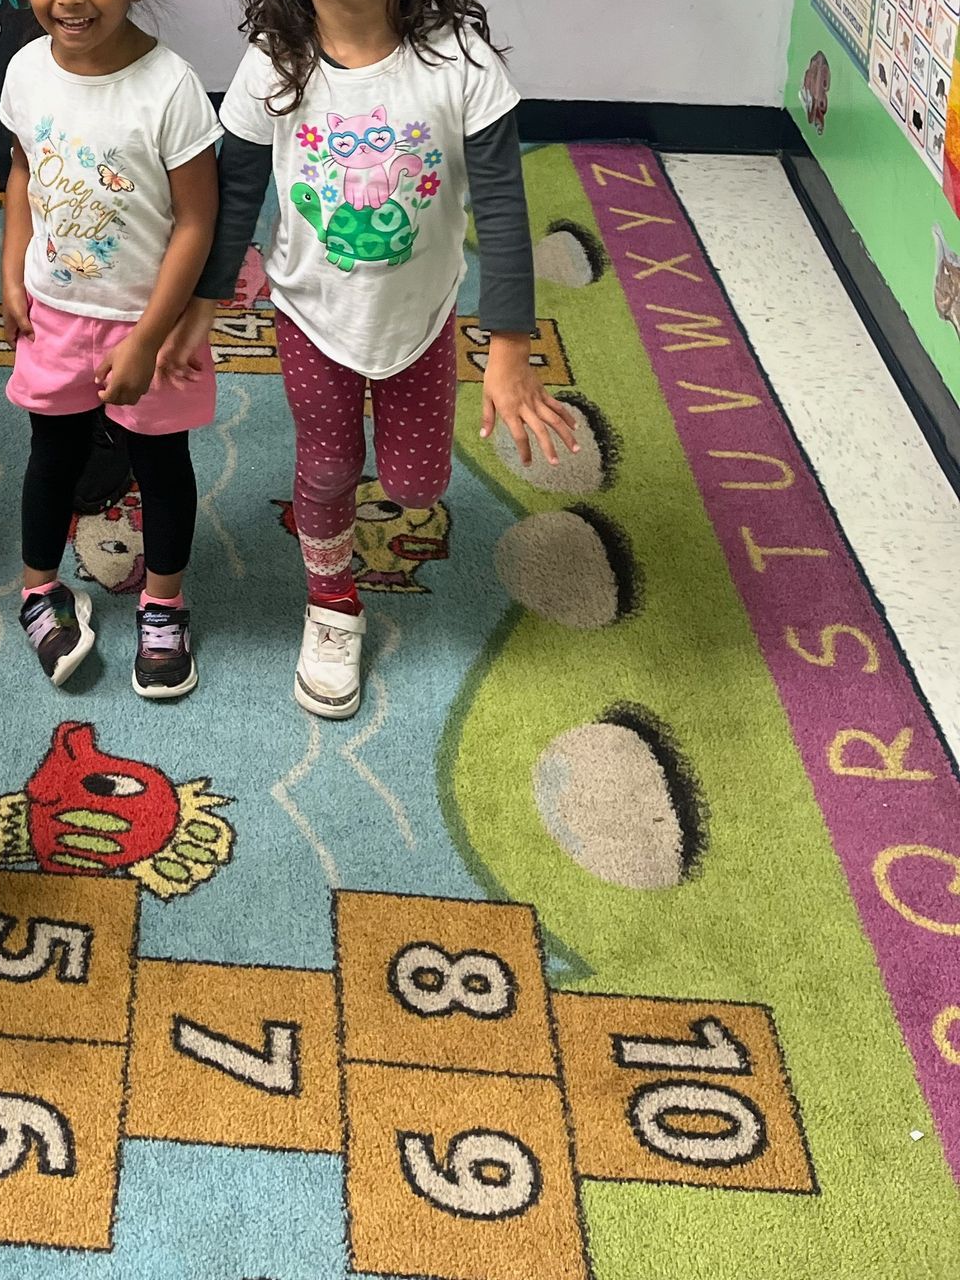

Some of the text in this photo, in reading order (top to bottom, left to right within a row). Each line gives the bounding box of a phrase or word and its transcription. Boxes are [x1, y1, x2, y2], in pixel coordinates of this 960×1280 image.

[37, 153, 87, 196] One
[592, 162, 659, 188] Z
[68, 189, 104, 218] of a
[607, 205, 674, 233] Y
[624, 251, 704, 283] X
[645, 302, 733, 352] W
[675, 380, 763, 416] V
[705, 449, 796, 492] U
[740, 526, 829, 573] T
[785, 622, 882, 675] S
[826, 726, 936, 782] R
[386, 940, 519, 1021] 8
[171, 1014, 302, 1098] 7
[611, 1014, 768, 1169] 10
[396, 1127, 542, 1222] 9
